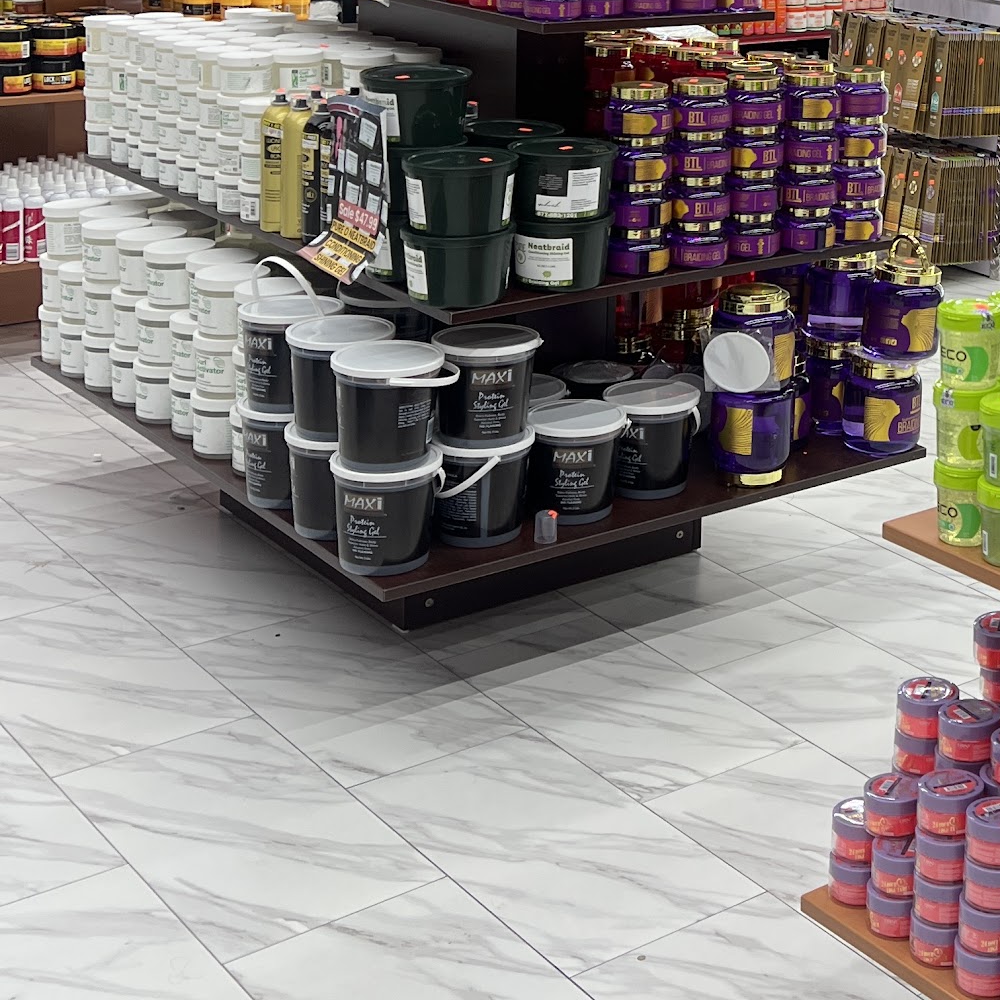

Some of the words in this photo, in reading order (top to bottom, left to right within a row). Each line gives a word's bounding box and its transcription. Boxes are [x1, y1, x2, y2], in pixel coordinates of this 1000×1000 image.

[688, 111, 705, 124] BTL
[763, 149, 778, 162] BTL
[684, 156, 702, 170] BTL
[847, 181, 863, 195] BTL
[786, 188, 801, 203] BTL
[694, 202, 713, 215] BTL
[339, 202, 355, 220] Sale
[354, 210, 378, 231] $47.99
[528, 242, 570, 251] Neatbraid
[741, 243, 752, 252] GEL
[940, 346, 967, 362] ECO
[478, 392, 505, 402] Protein
[472, 400, 495, 411] Styling
[497, 398, 509, 409] Gel
[559, 470, 586, 479] Protein
[554, 477, 576, 488] Styling
[578, 476, 589, 486] Gel
[349, 515, 375, 526] Protein
[346, 524, 368, 536] Styling
[368, 527, 381, 536] Gel
